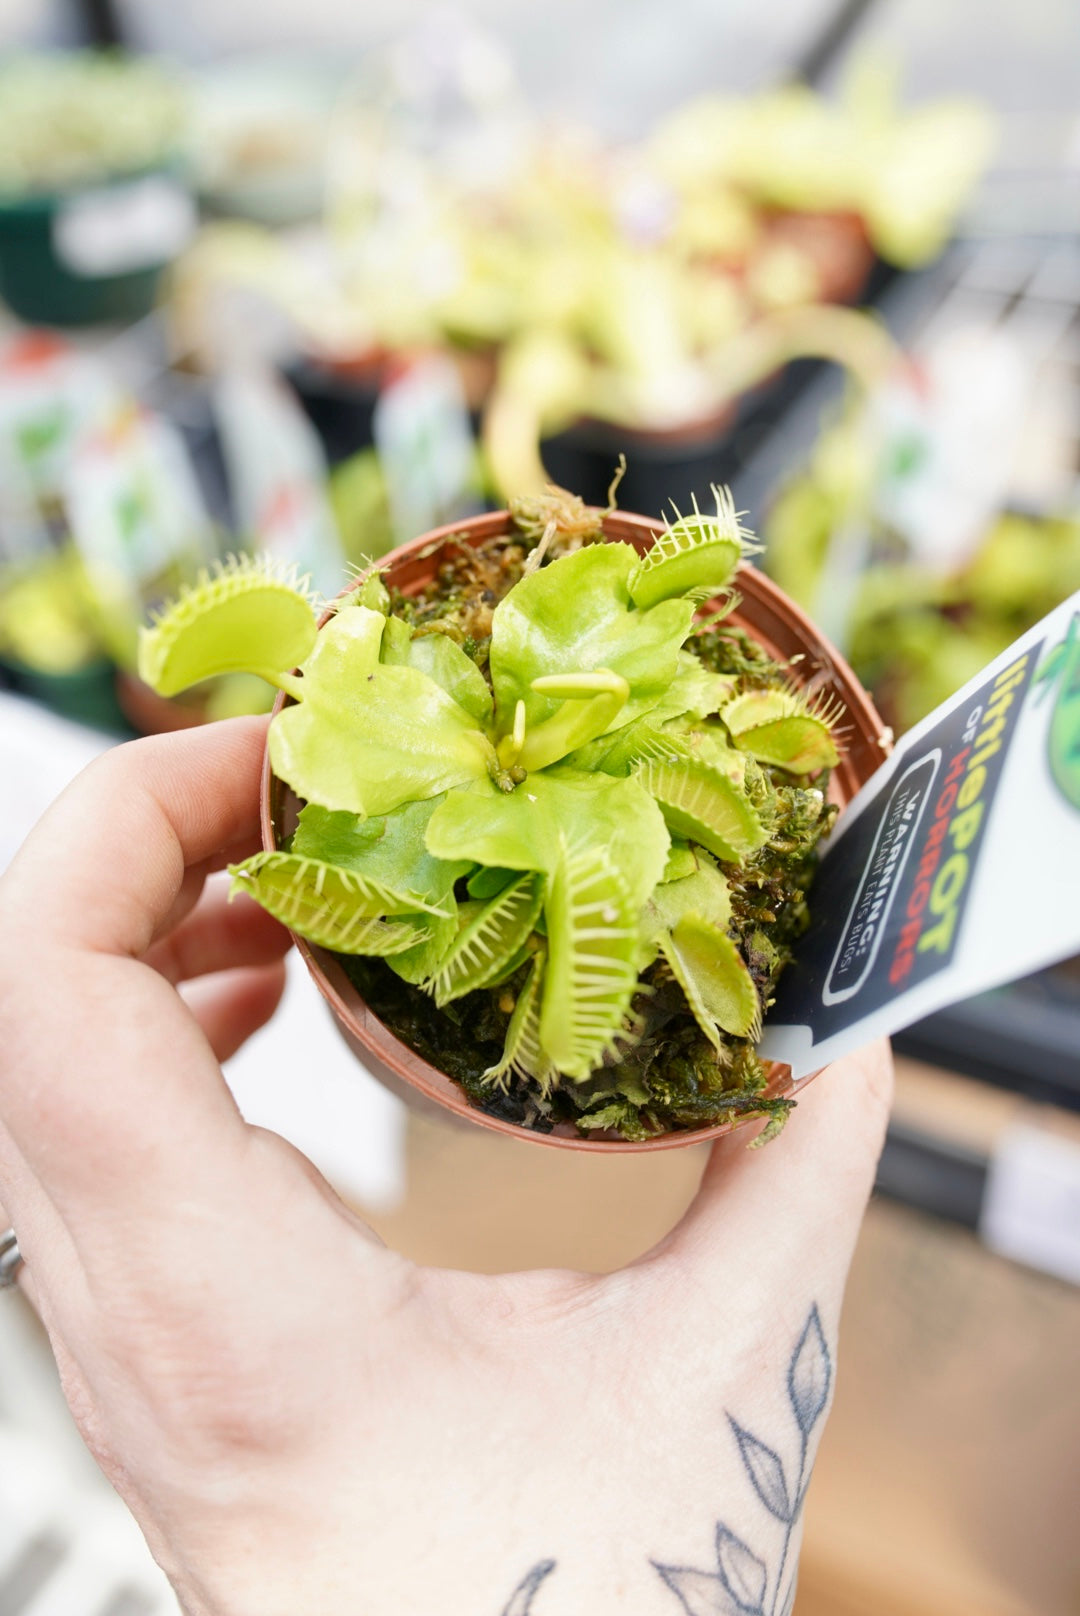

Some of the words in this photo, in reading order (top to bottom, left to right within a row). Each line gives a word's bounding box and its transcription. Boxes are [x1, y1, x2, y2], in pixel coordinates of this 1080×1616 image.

[962, 705, 983, 743] OF
[889, 788, 911, 826] THIS
[872, 829, 896, 875] PLANT
[888, 746, 972, 986] HORRORS
[857, 881, 877, 919] EATS
